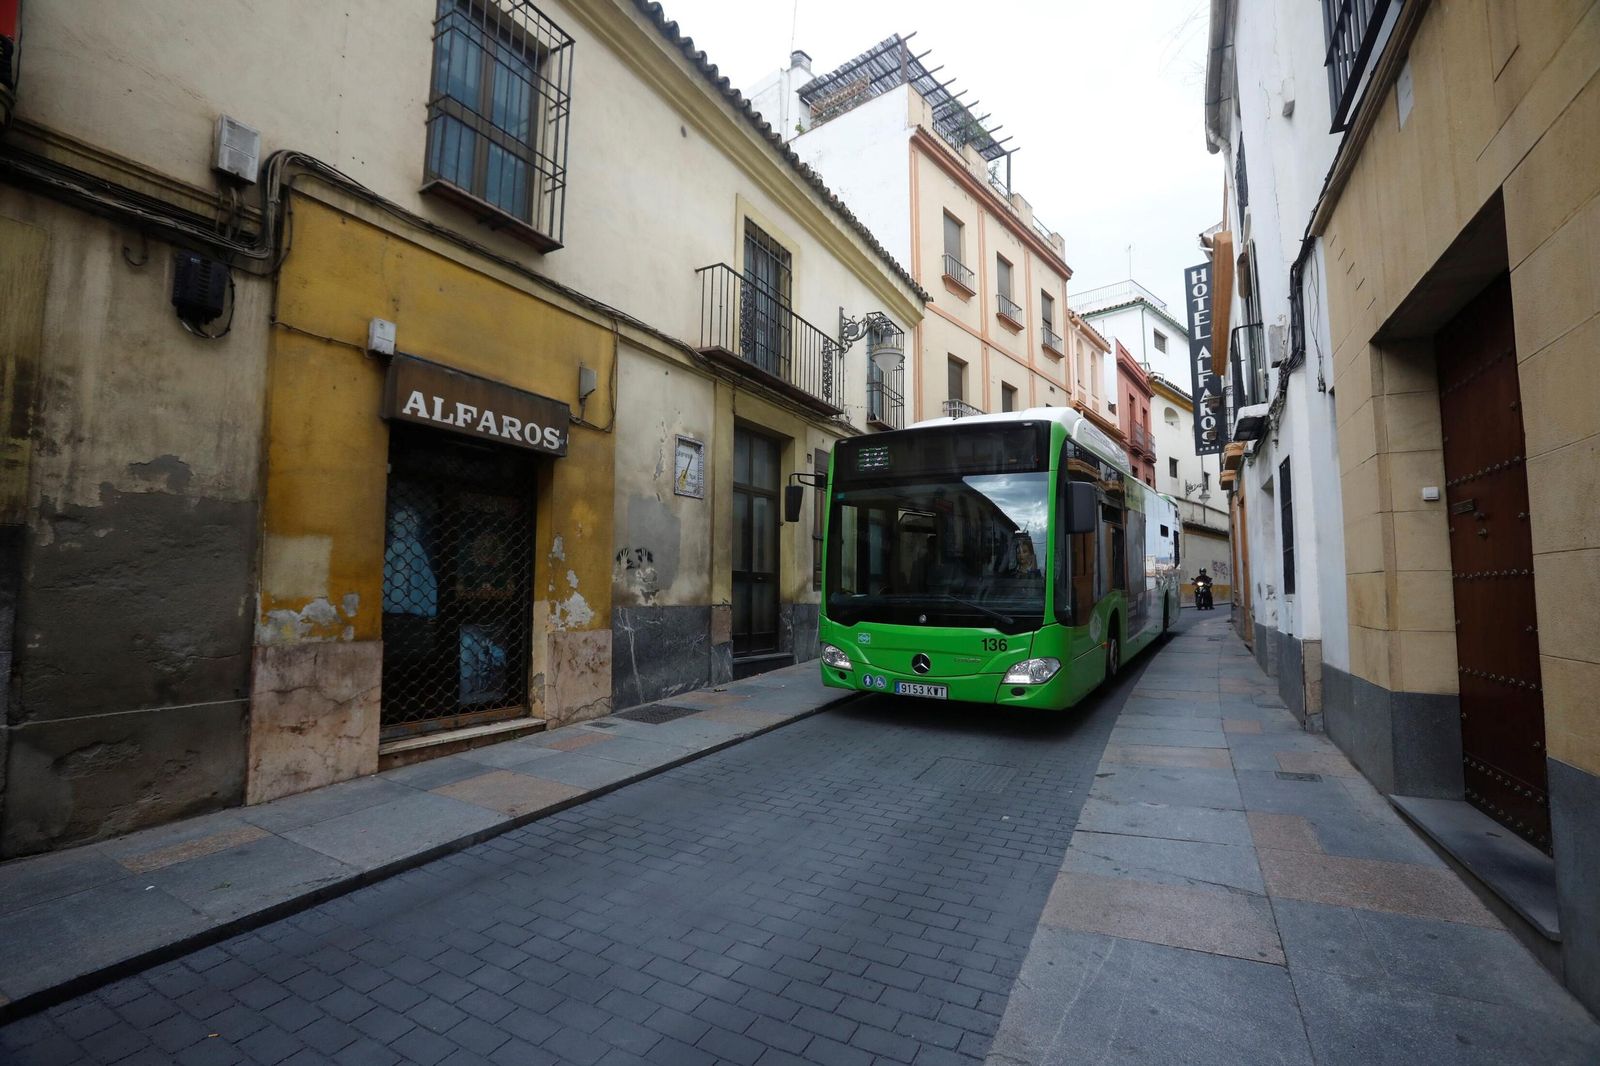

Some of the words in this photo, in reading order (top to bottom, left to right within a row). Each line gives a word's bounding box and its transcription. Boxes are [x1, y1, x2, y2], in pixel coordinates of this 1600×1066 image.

[1191, 267, 1212, 341] HOTEL
[402, 390, 561, 450] ALFAROS
[981, 638, 1008, 652] 136
[901, 683, 924, 695] 9153
